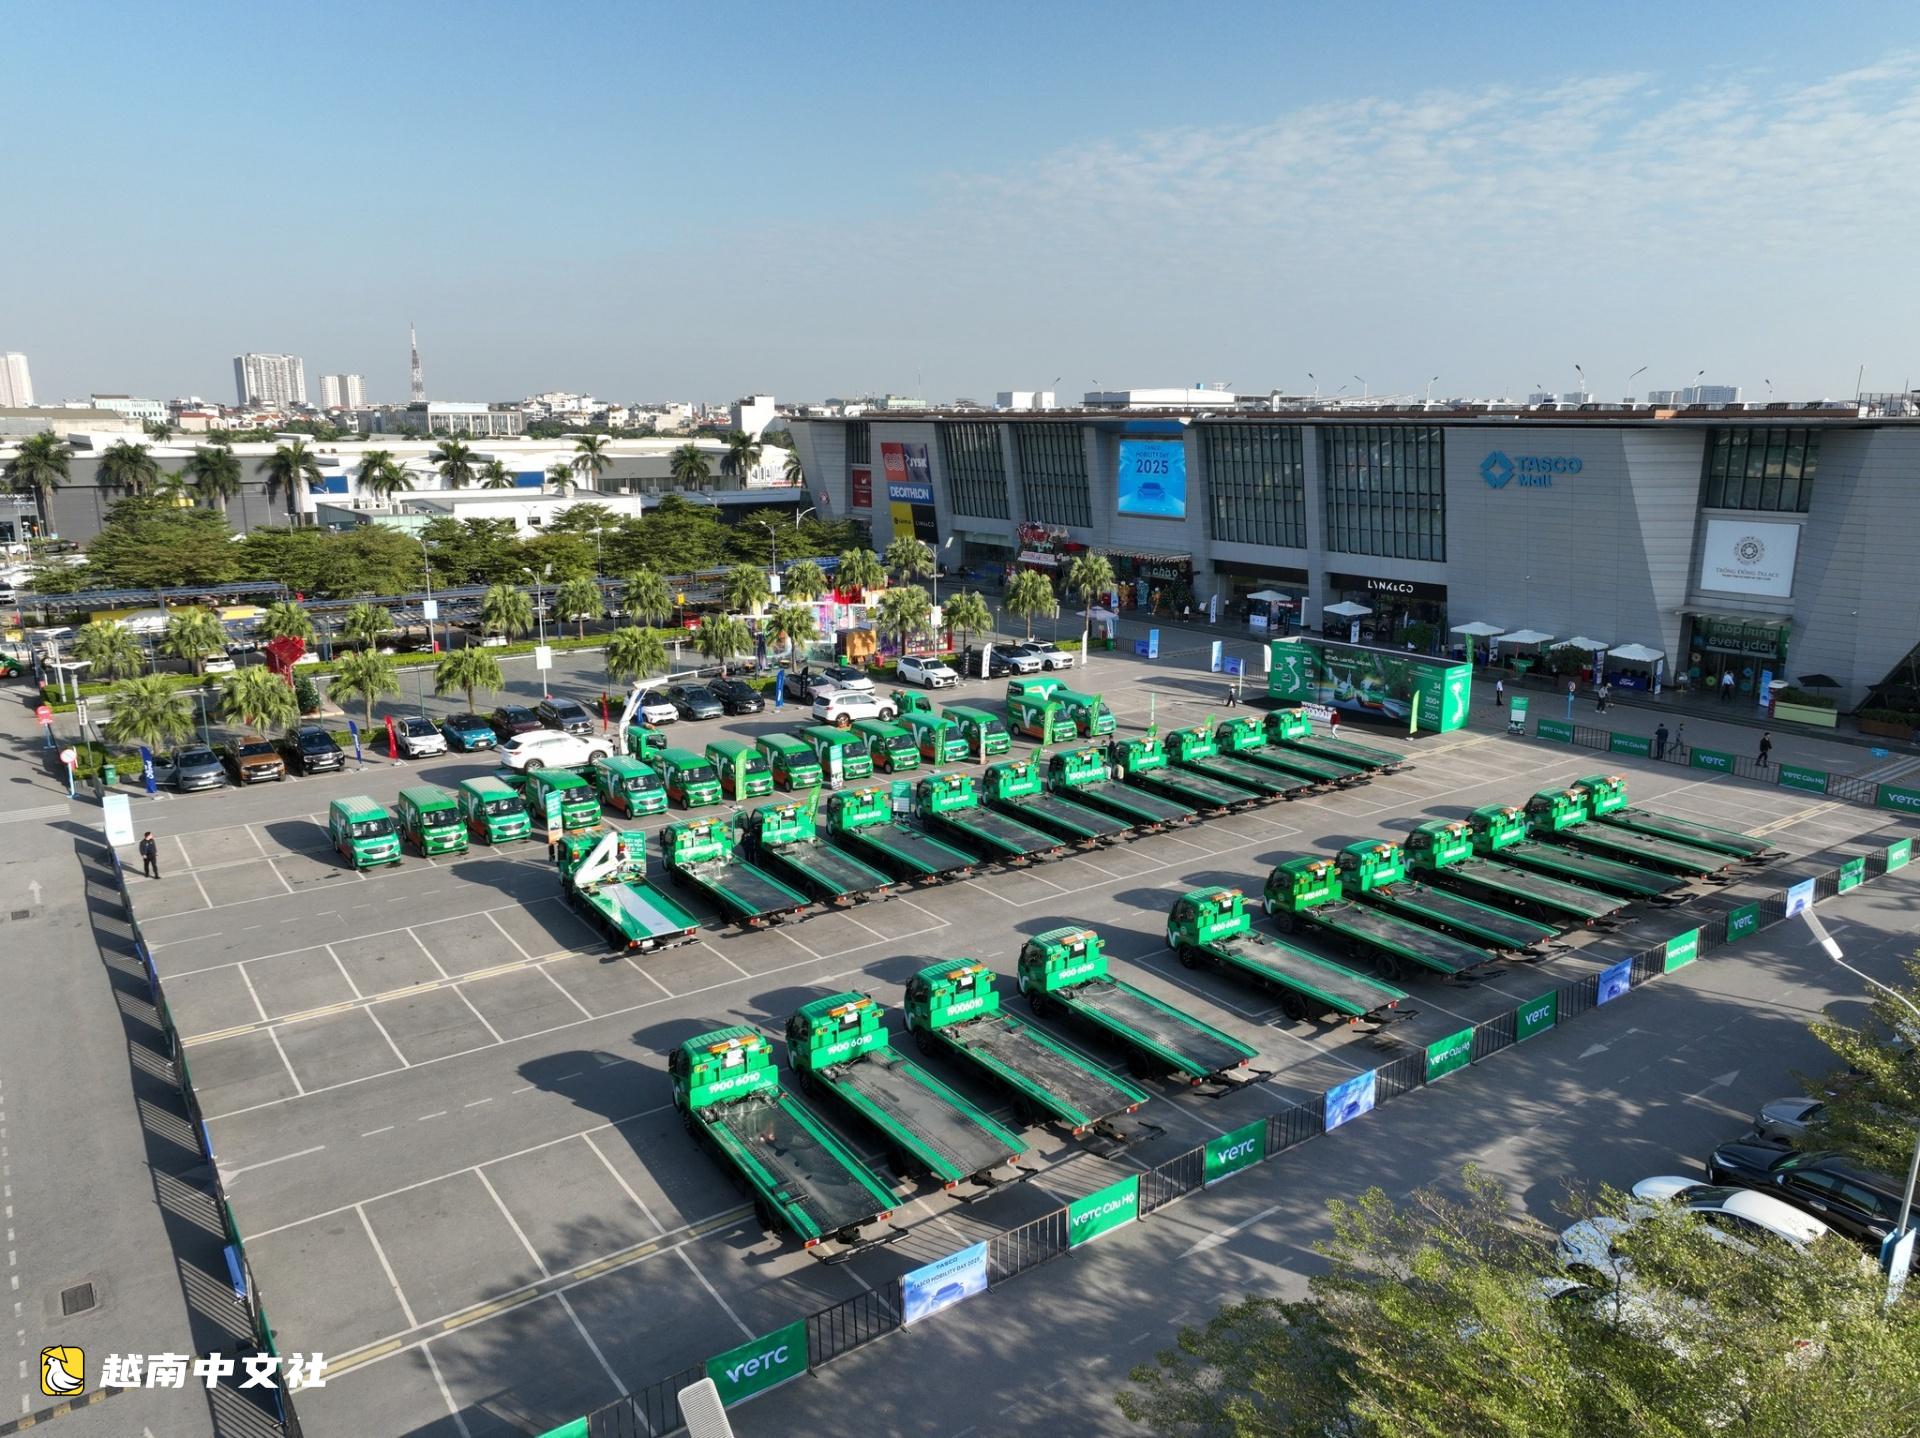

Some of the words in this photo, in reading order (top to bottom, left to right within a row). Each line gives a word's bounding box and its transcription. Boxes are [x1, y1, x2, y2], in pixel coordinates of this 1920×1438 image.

[909, 458, 927, 468] JYSK
[1136, 459, 1169, 474] 2025
[1515, 456, 1582, 473] TASCO
[1518, 475, 1552, 487] Mall
[890, 486, 929, 500] DECATHLON
[1708, 635, 1777, 653] everyday
[1433, 682, 1441, 690] 34
[1619, 679, 1635, 687] Ford
[1424, 711, 1439, 720] 200+
[145, 760, 154, 779] Ford
[1059, 968, 1076, 979] 1900
[828, 1043, 849, 1055] 1900
[851, 1034, 872, 1047] 6010
[709, 1081, 733, 1093] 1900
[736, 1073, 760, 1086] 6010
[936, 1256, 958, 1269] TASCO
[913, 1277, 931, 1290] TASCO
[930, 1267, 956, 1282] MOBILITY
[956, 1263, 967, 1272] DAY
